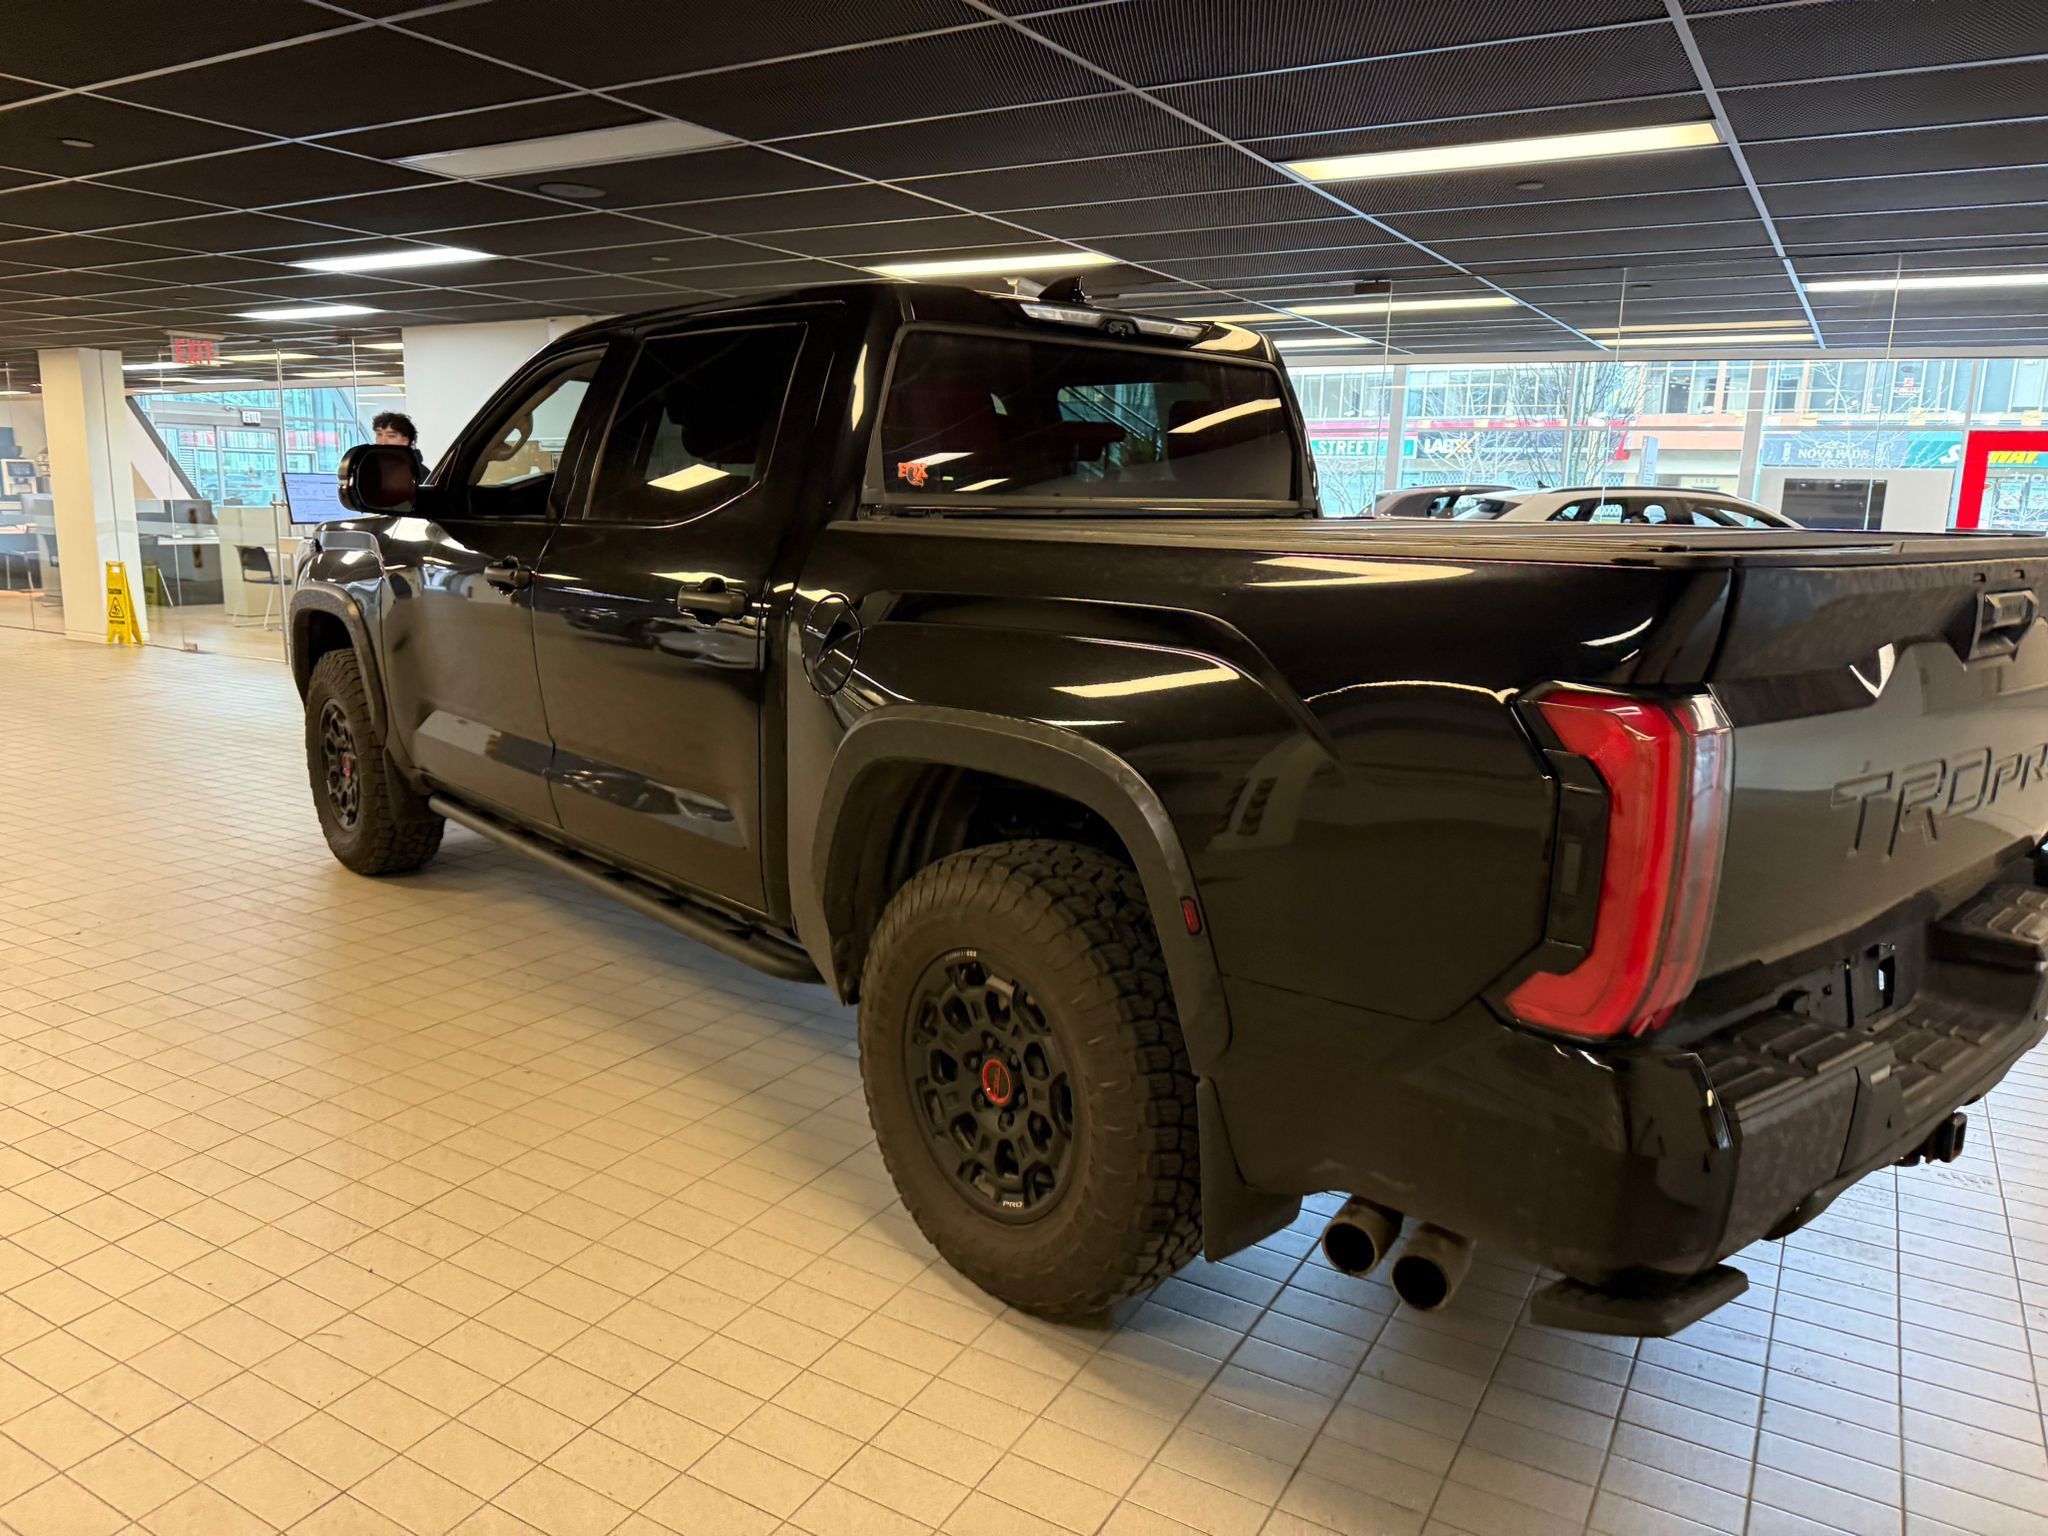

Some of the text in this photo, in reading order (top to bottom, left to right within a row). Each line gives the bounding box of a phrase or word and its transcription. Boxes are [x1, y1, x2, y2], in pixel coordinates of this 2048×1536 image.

[175, 338, 214, 365] EXIT
[1319, 440, 1377, 456] STREET
[1797, 448, 1834, 460] NOVA
[898, 462, 928, 488] FOX
[1830, 742, 2048, 863] TRD PR
[1002, 1200, 1024, 1208] PRO
